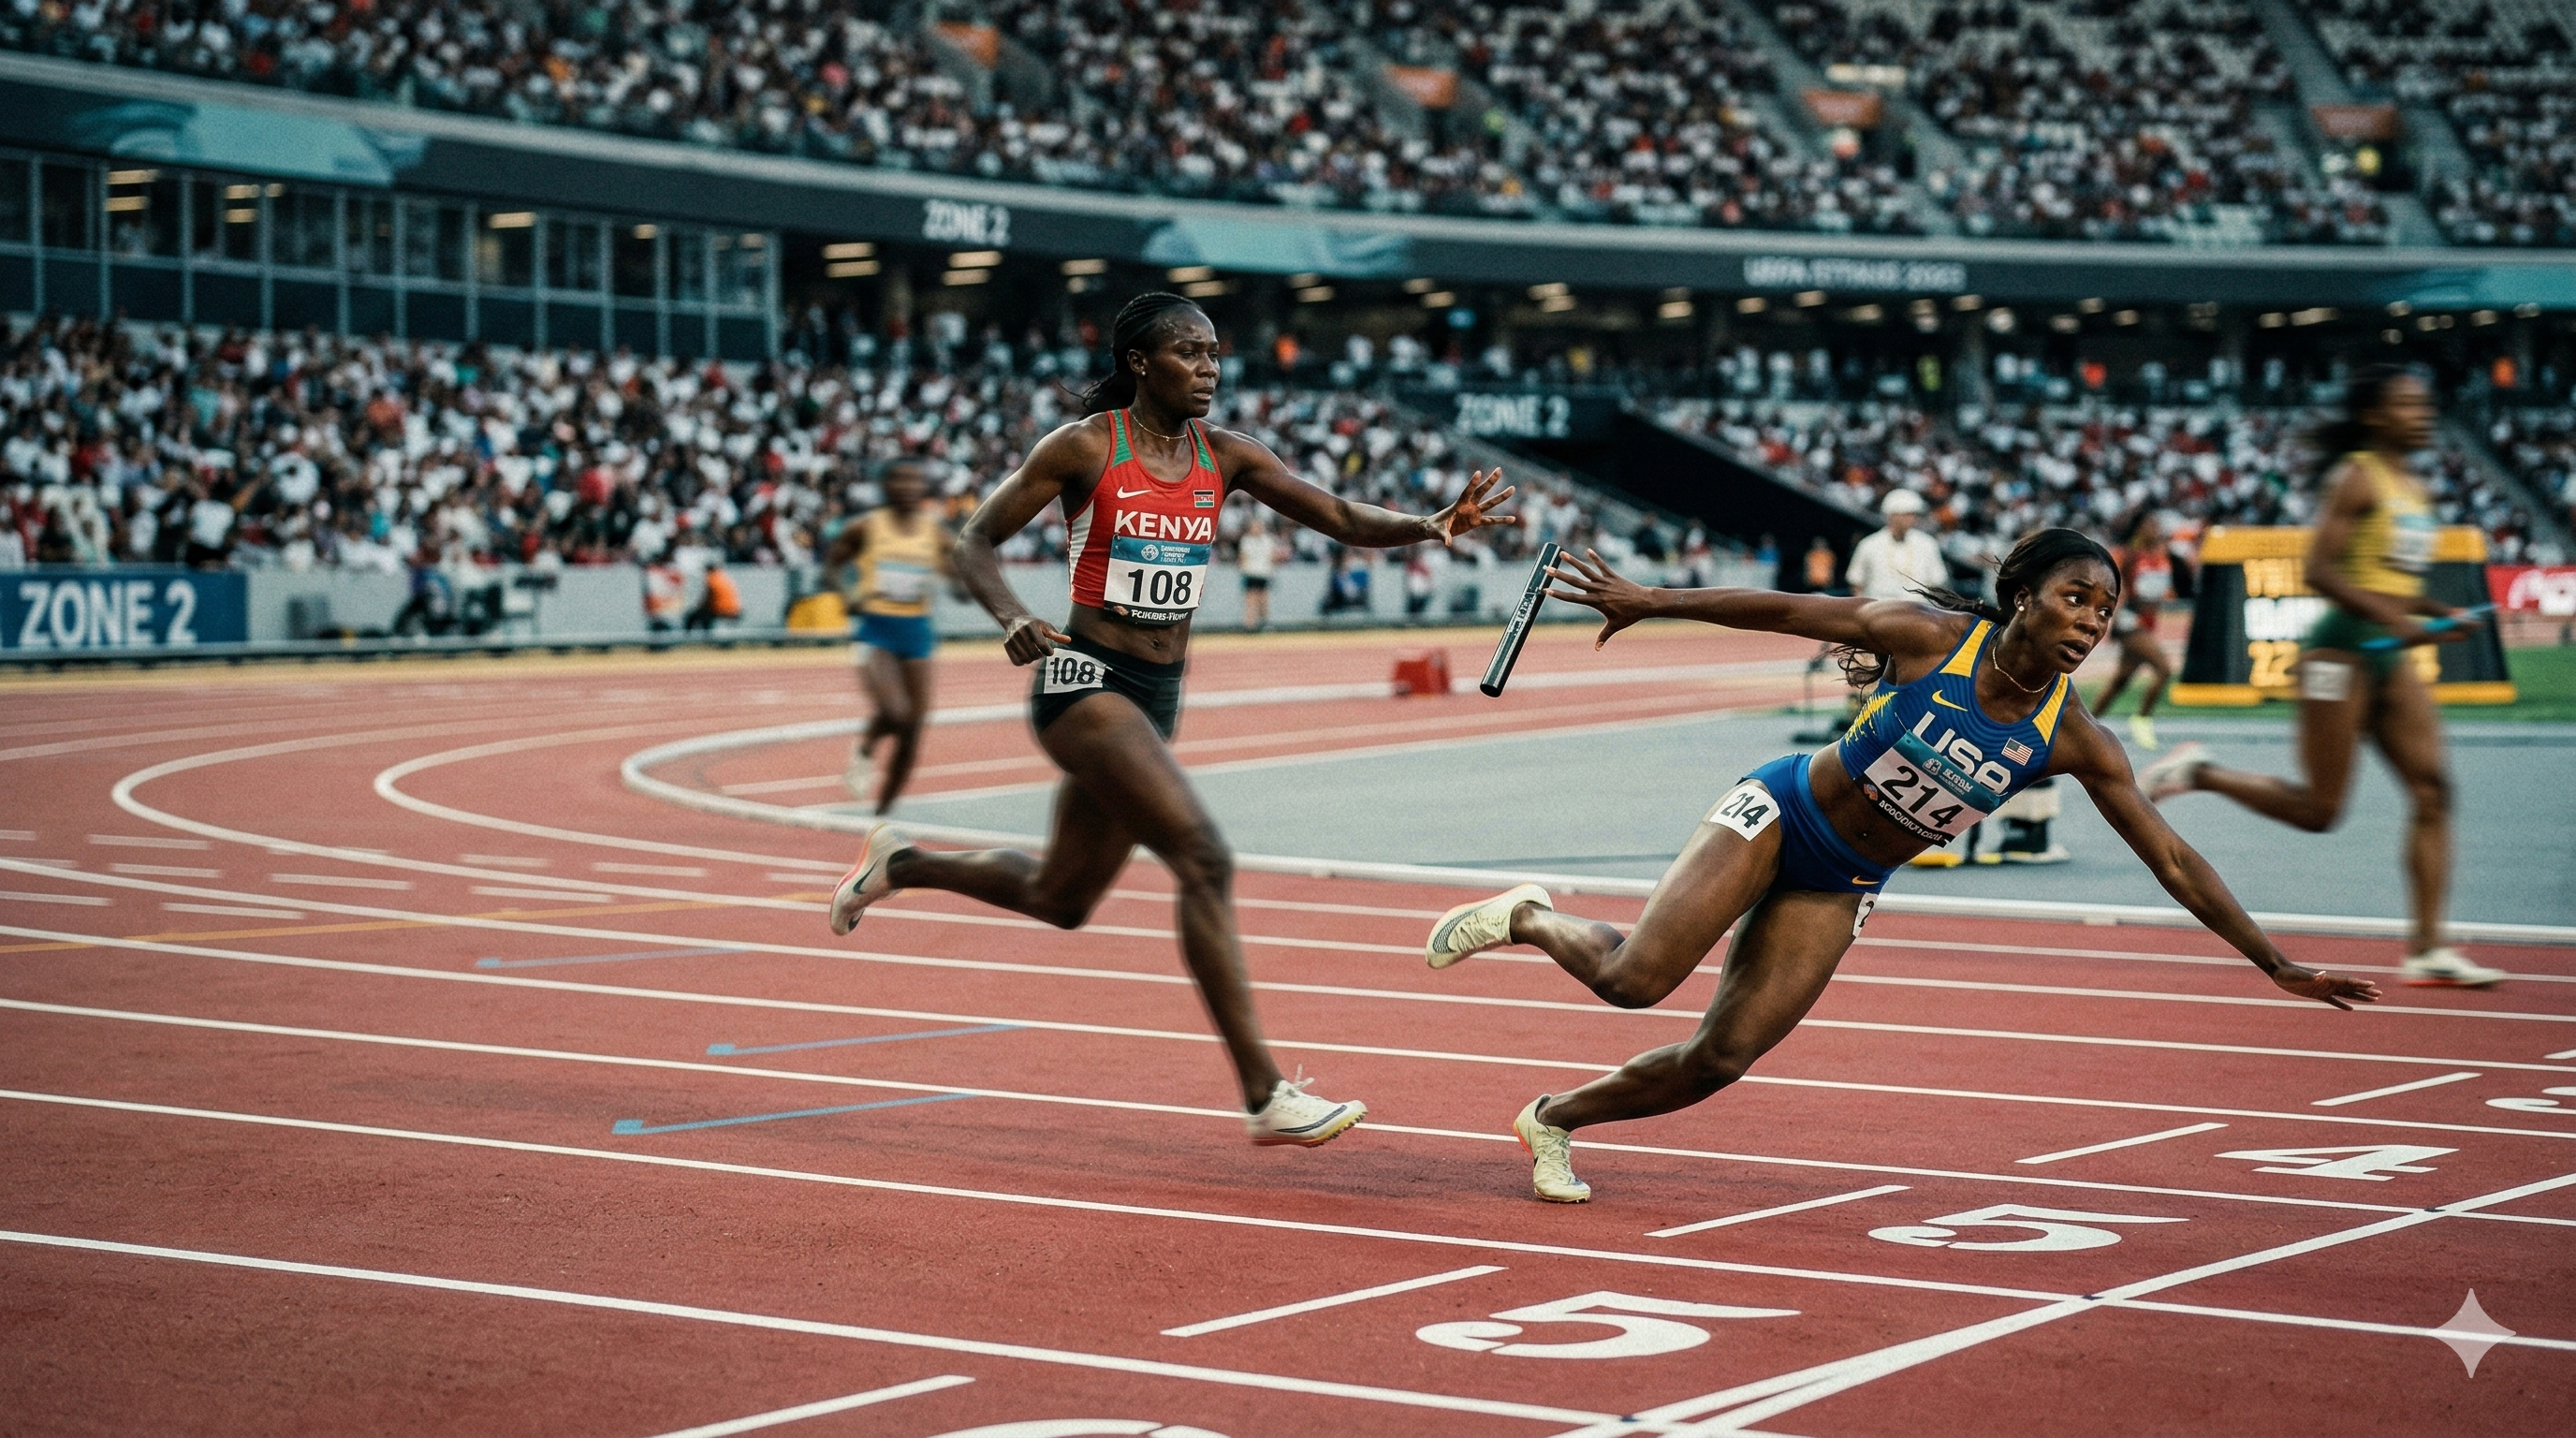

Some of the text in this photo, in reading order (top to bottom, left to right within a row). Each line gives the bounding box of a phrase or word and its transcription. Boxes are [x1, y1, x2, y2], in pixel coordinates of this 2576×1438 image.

[1456, 393, 1571, 438] ZONE 2
[1114, 509, 1212, 541] KENYA
[1128, 568, 1193, 606] 108
[18, 580, 198, 646] ZONE 2
[1049, 657, 1096, 684] 108
[1912, 711, 2012, 794] USA
[1720, 793, 1770, 829] 214
[1881, 765, 1964, 829] 214
[2214, 1144, 2460, 1181] 4
[1867, 1204, 2189, 1252] 5
[1415, 1291, 1801, 1359] 5
